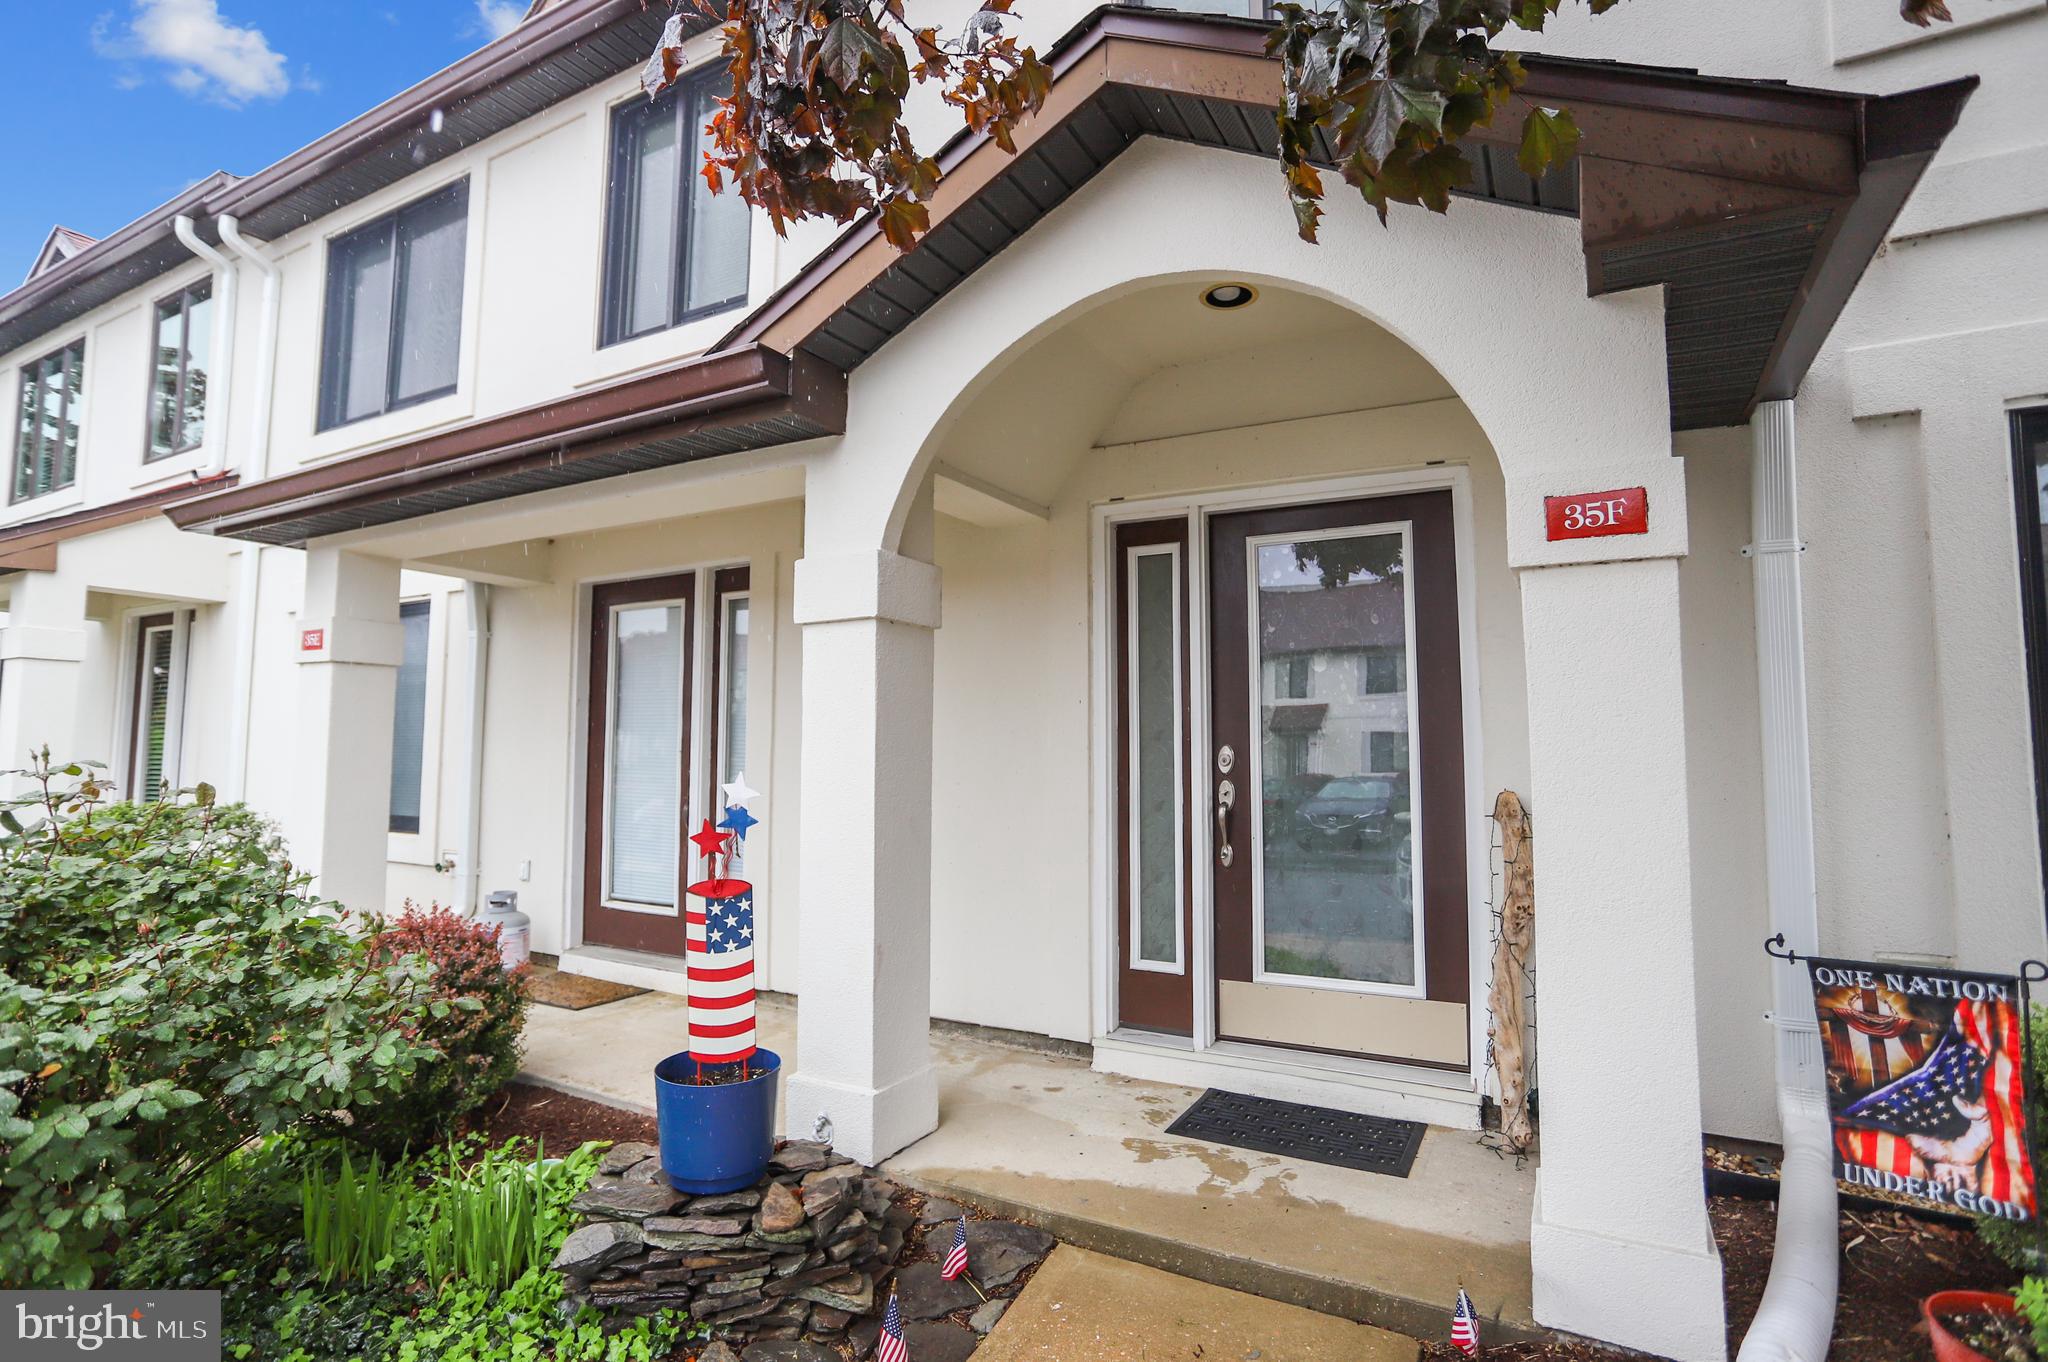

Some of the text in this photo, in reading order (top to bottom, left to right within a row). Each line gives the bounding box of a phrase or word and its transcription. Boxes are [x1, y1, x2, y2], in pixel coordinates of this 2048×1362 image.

[1564, 498, 1627, 529] 35F
[1815, 967, 2007, 1002] ONE NATION
[1843, 1163, 2028, 1221] UNDER GOD
